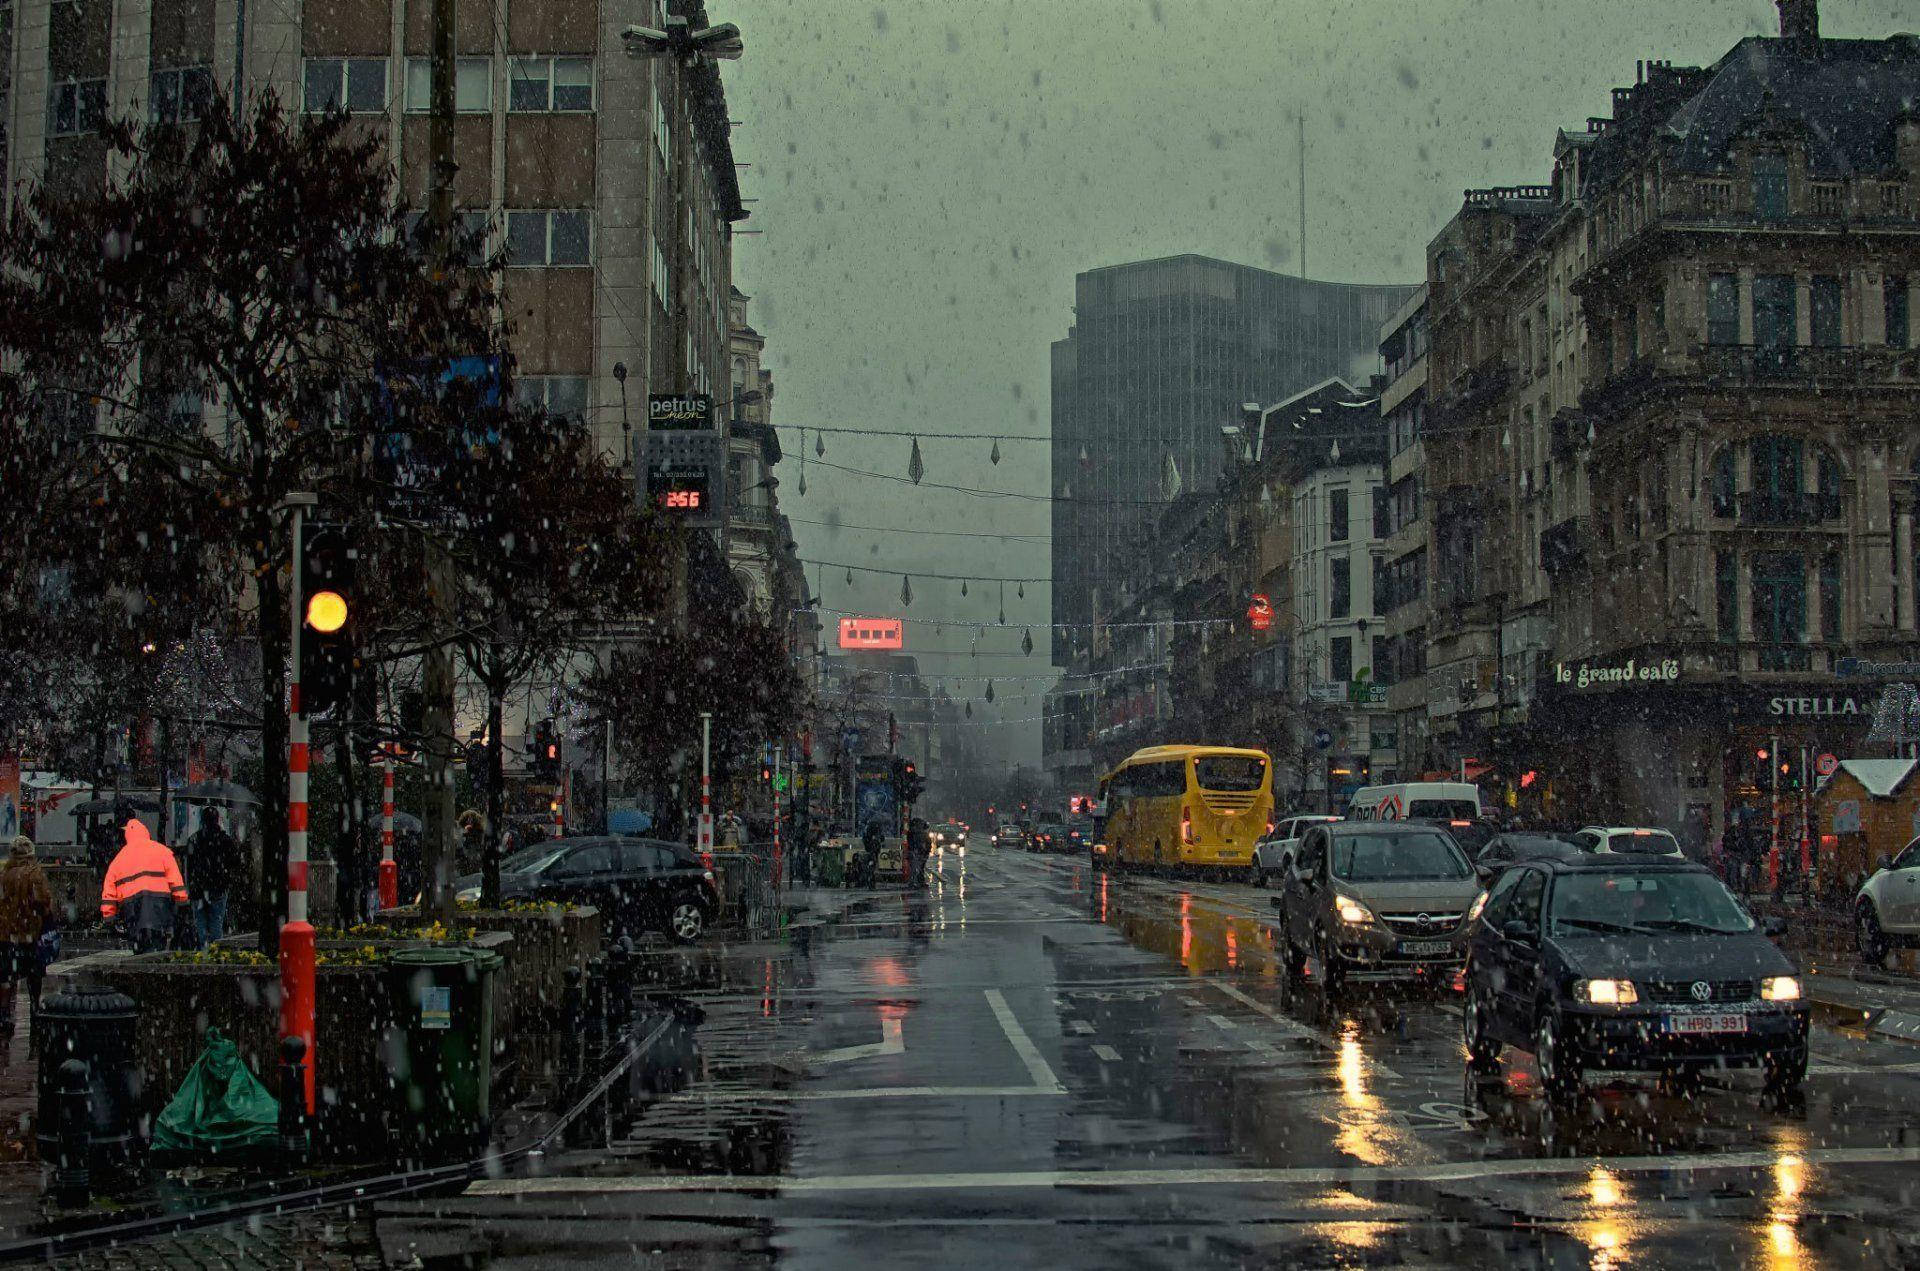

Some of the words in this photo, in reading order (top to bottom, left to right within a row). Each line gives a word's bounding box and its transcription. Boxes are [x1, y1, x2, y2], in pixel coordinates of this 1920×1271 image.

[650, 397, 707, 416] petrus
[1556, 662, 1572, 683] le
[1577, 659, 1635, 688] grand
[1770, 697, 1858, 715] STELLA
